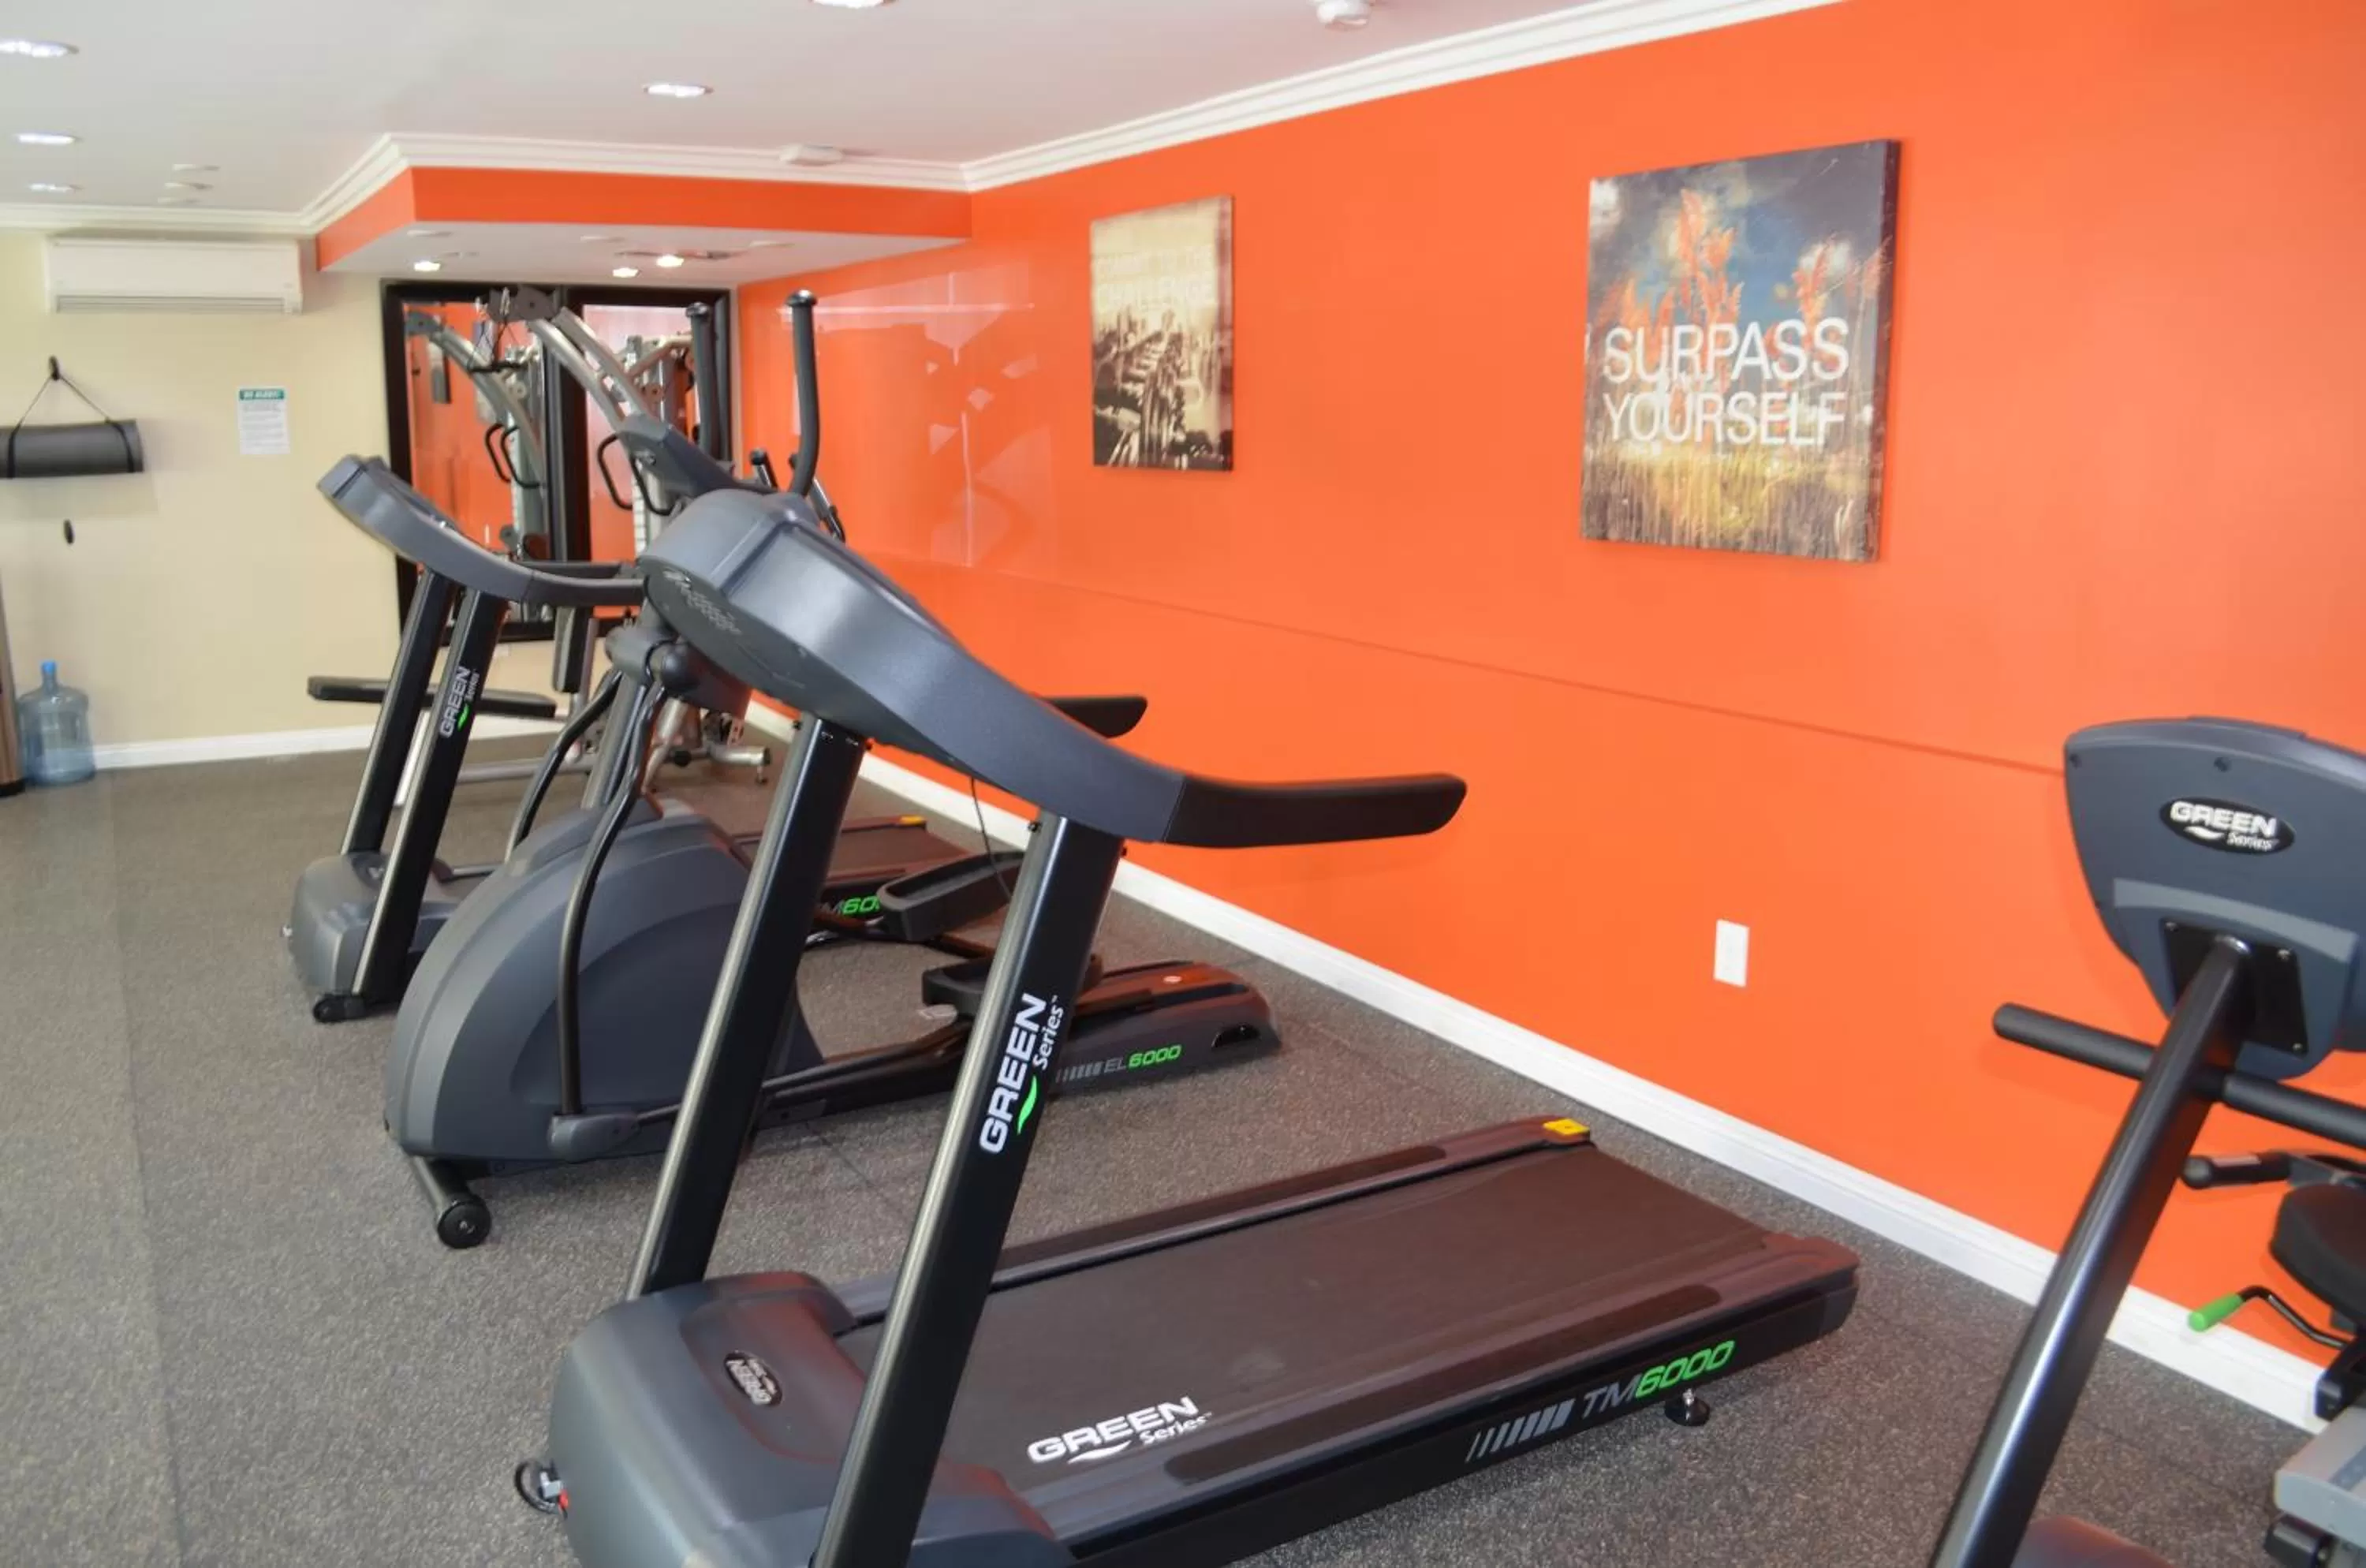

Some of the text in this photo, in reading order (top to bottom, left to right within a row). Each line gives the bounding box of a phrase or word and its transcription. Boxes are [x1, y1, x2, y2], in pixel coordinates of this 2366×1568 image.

[1603, 318, 1850, 384] SURPASS
[1602, 391, 1846, 450] YOURSELF
[440, 665, 472, 738] GREEN
[2170, 800, 2278, 838] GREEN
[1032, 1006, 1065, 1071] Series
[1103, 1044, 1182, 1073] EL6000
[979, 991, 1047, 1154] GREEN
[1580, 1339, 1737, 1420] TM6000
[1027, 1395, 1200, 1464] GREEN
[1139, 1415, 1207, 1447] Series
